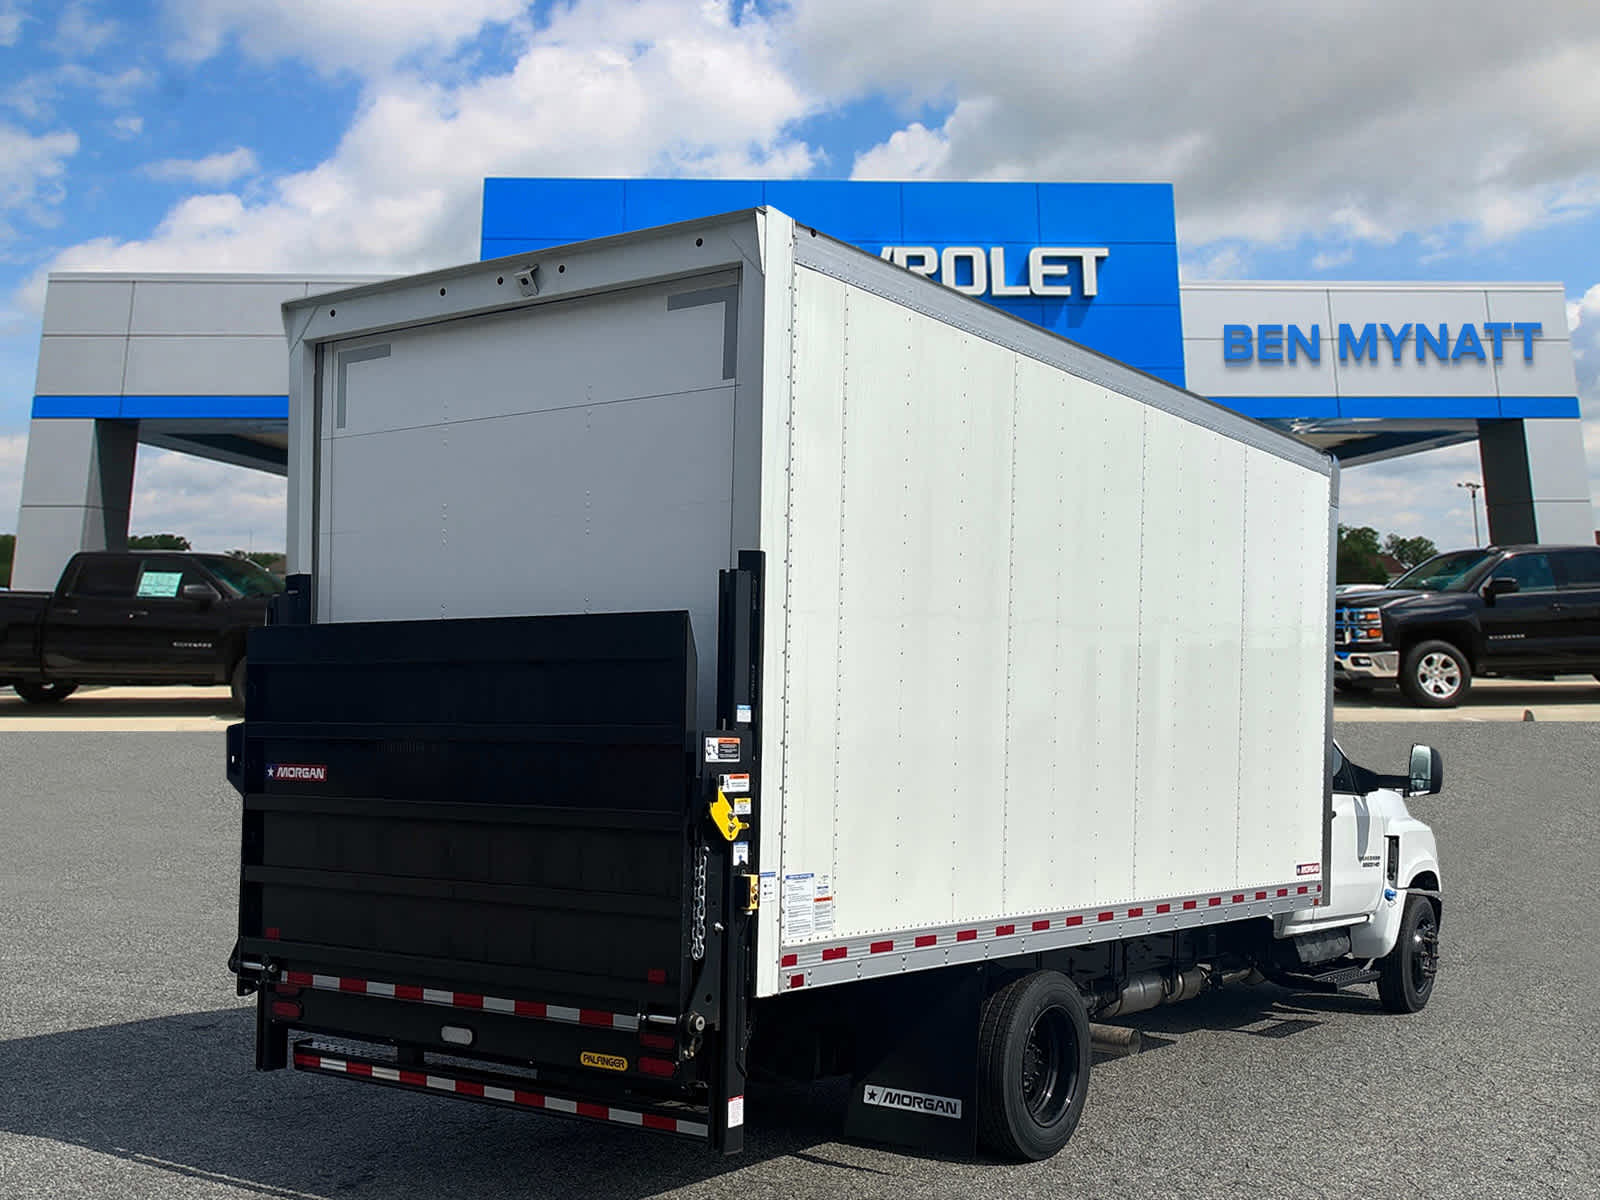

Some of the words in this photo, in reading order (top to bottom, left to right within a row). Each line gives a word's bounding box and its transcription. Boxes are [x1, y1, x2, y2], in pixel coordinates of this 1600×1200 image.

[880, 246, 1109, 296] ROLET
[1223, 324, 1321, 362] BEN
[1338, 322, 1543, 362] MYNATT
[277, 766, 325, 779] MORGAN
[882, 1091, 957, 1115] MORGAN
